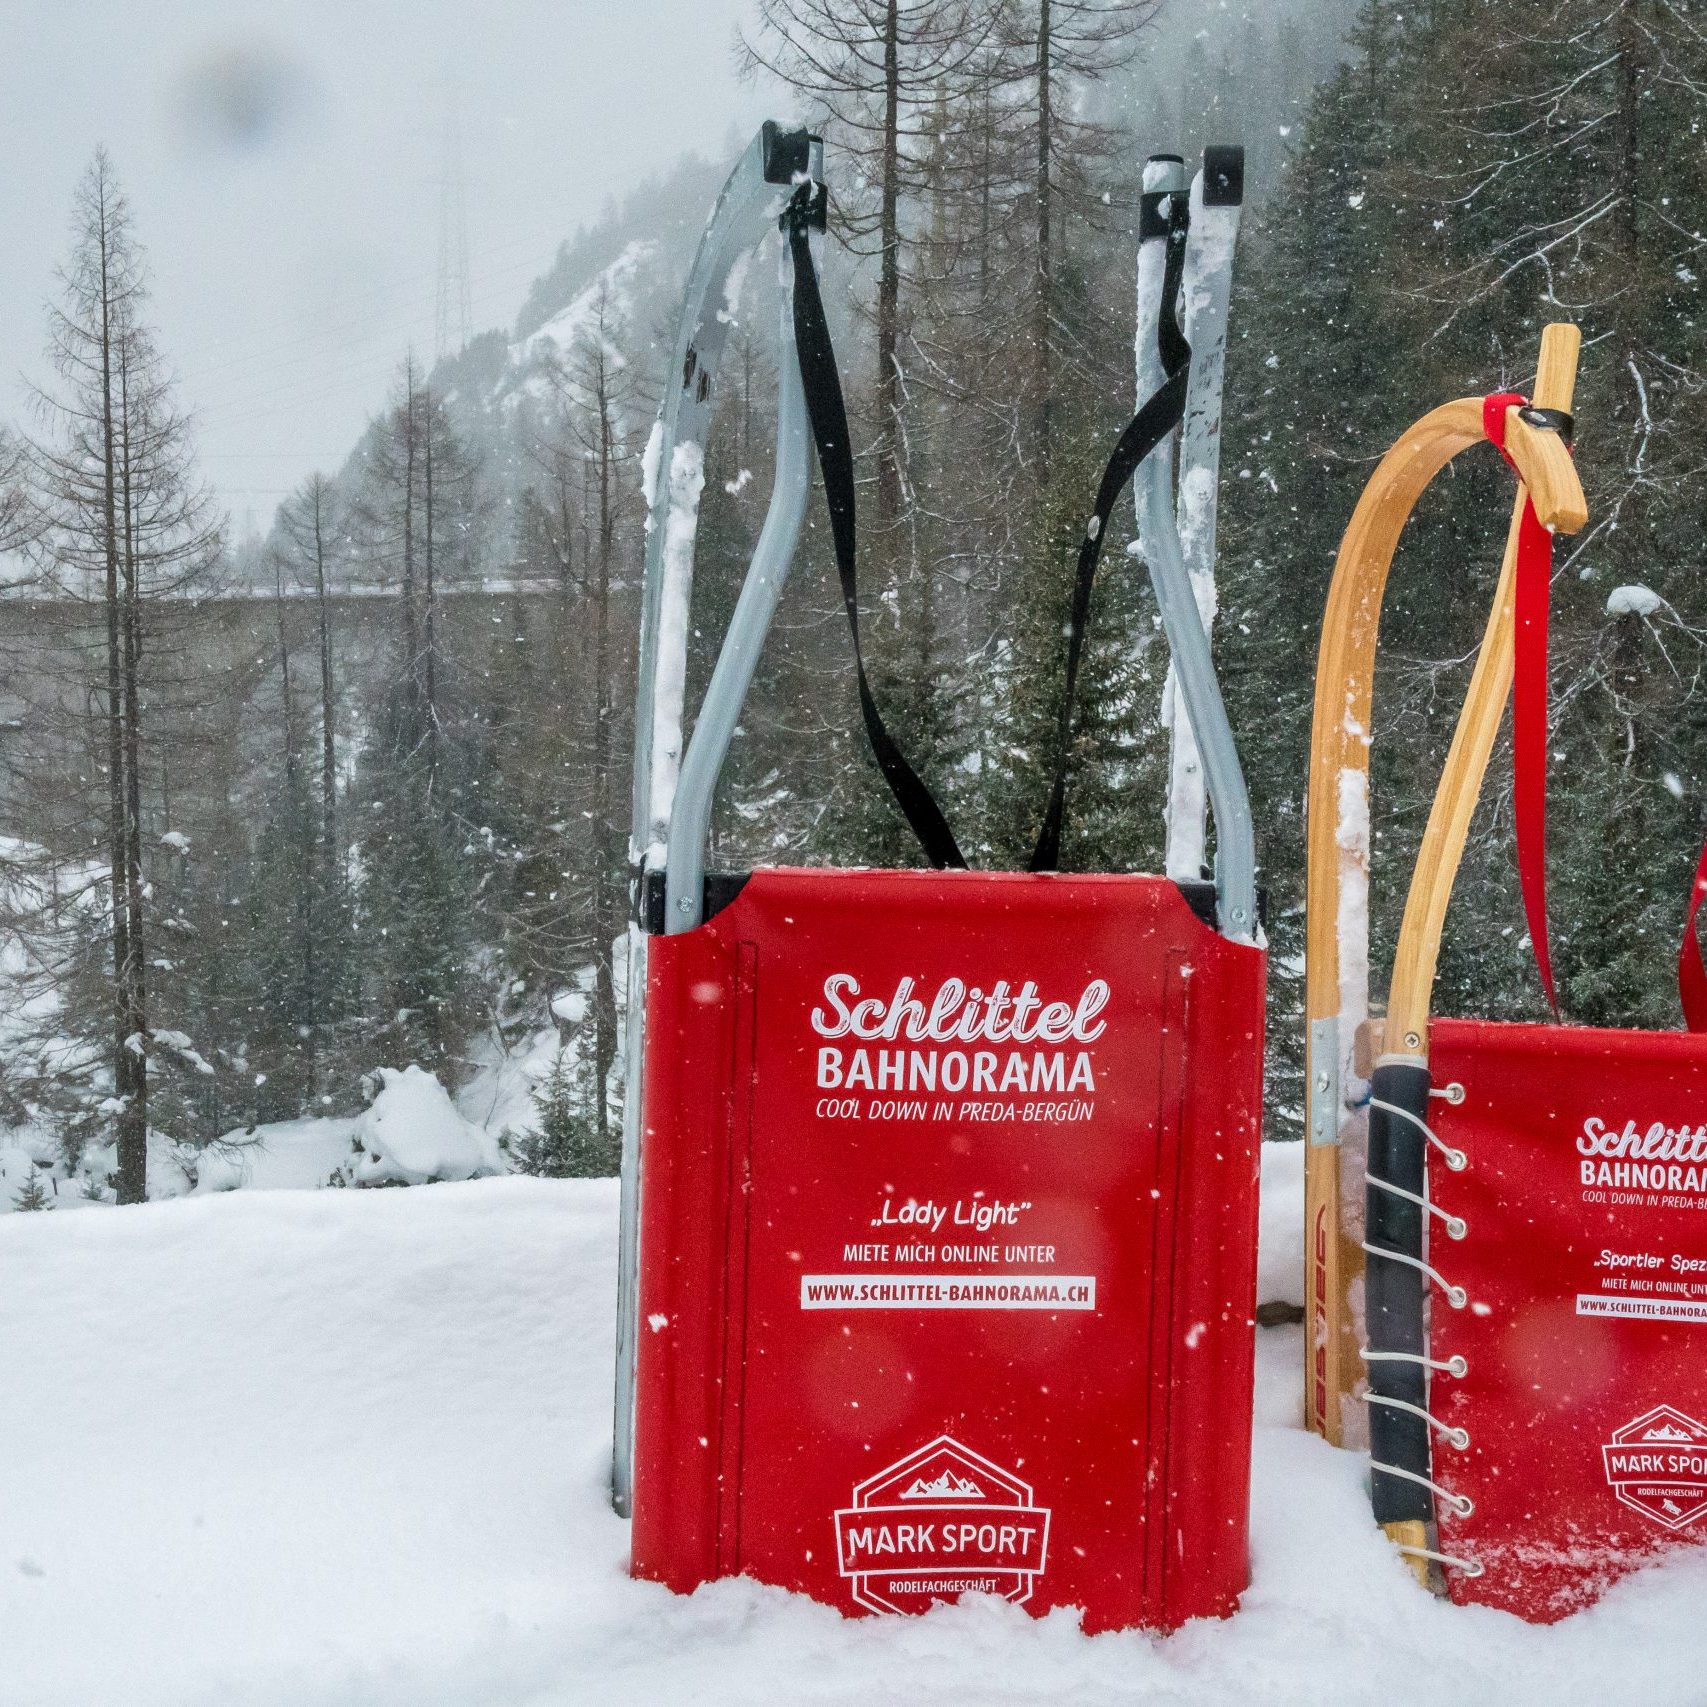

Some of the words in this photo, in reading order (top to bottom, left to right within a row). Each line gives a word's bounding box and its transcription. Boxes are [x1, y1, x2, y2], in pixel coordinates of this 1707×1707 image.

[811, 974, 1110, 1043] Schlittel
[817, 1047, 1095, 1092] BAHNORAMA
[816, 1099, 861, 1119] COOL
[869, 1100, 928, 1120] DOWN
[933, 1102, 954, 1121] IN
[959, 1099, 1094, 1121] PREDA-BERGÜN
[1576, 1117, 1707, 1163] Schlitt
[1583, 1191, 1607, 1203] COOL
[1611, 1193, 1644, 1206] DOWN
[1647, 1195, 1658, 1206] IN
[843, 1244, 889, 1262] MIETE
[895, 1245, 936, 1263] MICH
[941, 1245, 1000, 1263] ONLINE
[1005, 1246, 1055, 1263] UNTER
[1671, 1254, 1707, 1275] Spez
[808, 1285, 1089, 1302] WWW.SCHLITTEL-BAHNORAMA.CH
[1602, 1278, 1627, 1290] MIETE
[1630, 1280, 1653, 1292] MICH
[1656, 1281, 1688, 1293] ONLINE
[1611, 1455, 1664, 1473] MARK
[1637, 1487, 1704, 1498] RODELFACHGESCHÄFT
[849, 1525, 935, 1556] MARK
[942, 1524, 1036, 1555] SPORT
[889, 1578, 997, 1594] RODELFACHGESCHÄFT
